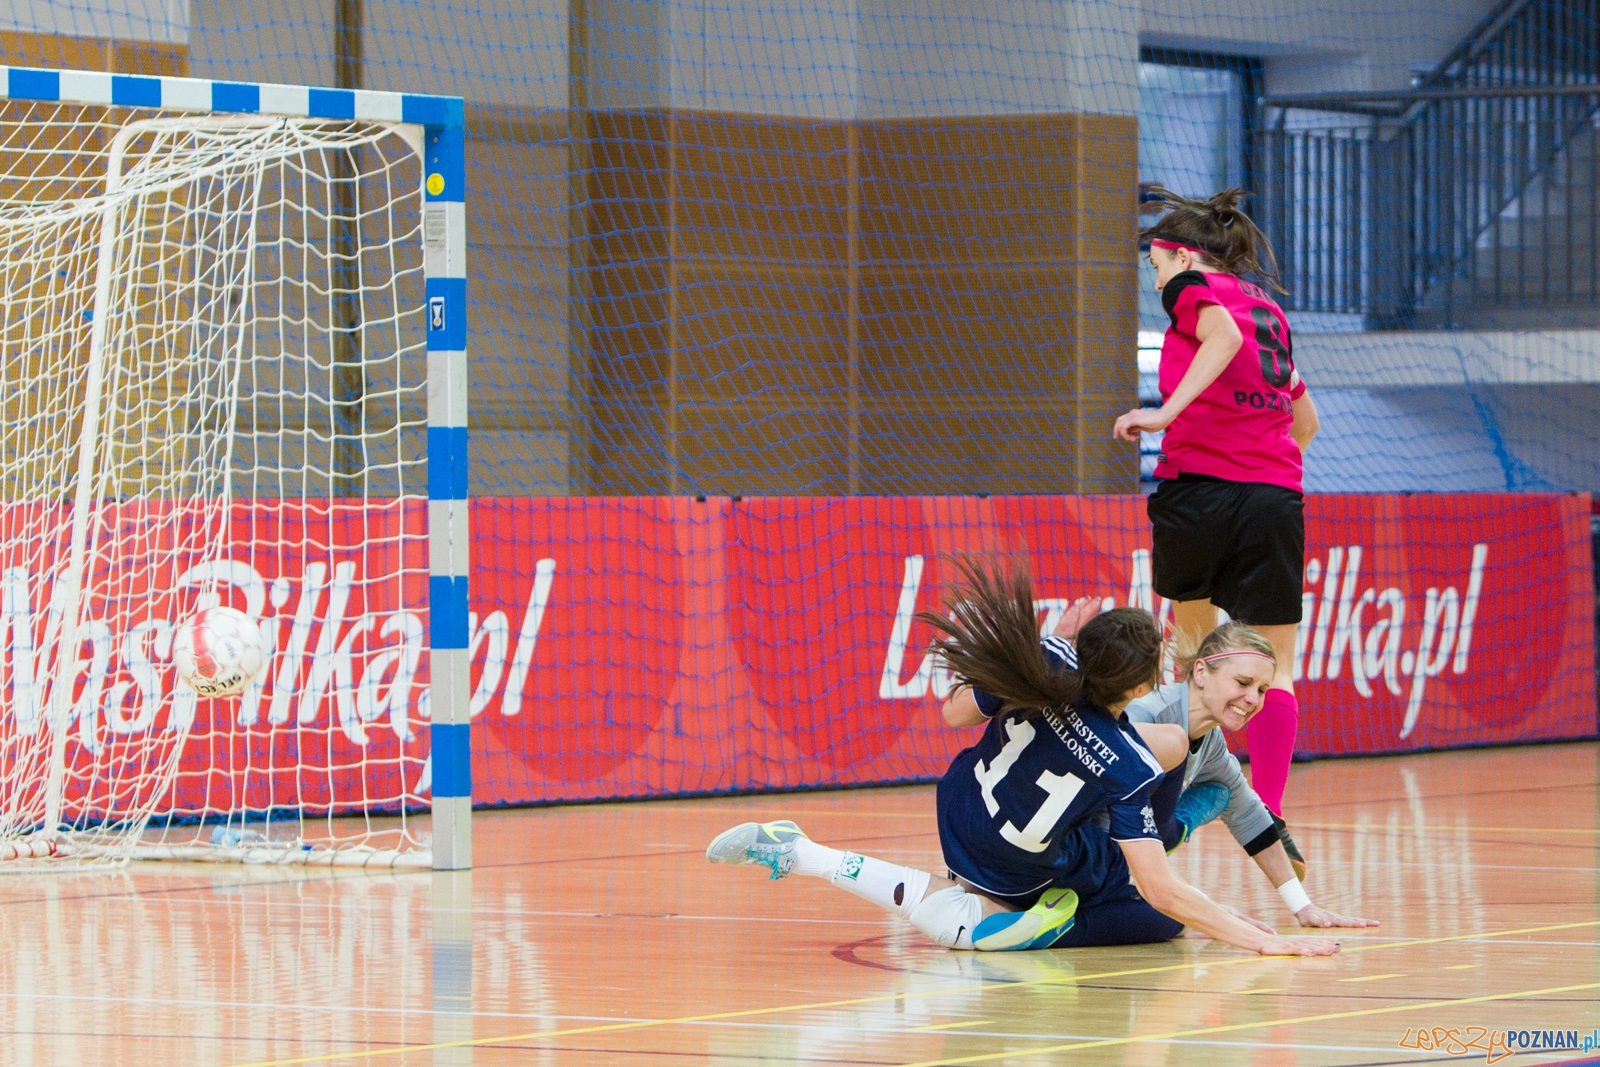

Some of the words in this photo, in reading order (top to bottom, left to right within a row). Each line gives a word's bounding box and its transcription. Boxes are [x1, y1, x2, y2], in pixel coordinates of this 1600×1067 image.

[1251, 306, 1291, 388] 9
[1040, 704, 1106, 778] GIELLOŃSKI
[1062, 703, 1120, 766] VERSYTET
[974, 716, 1086, 854] 11
